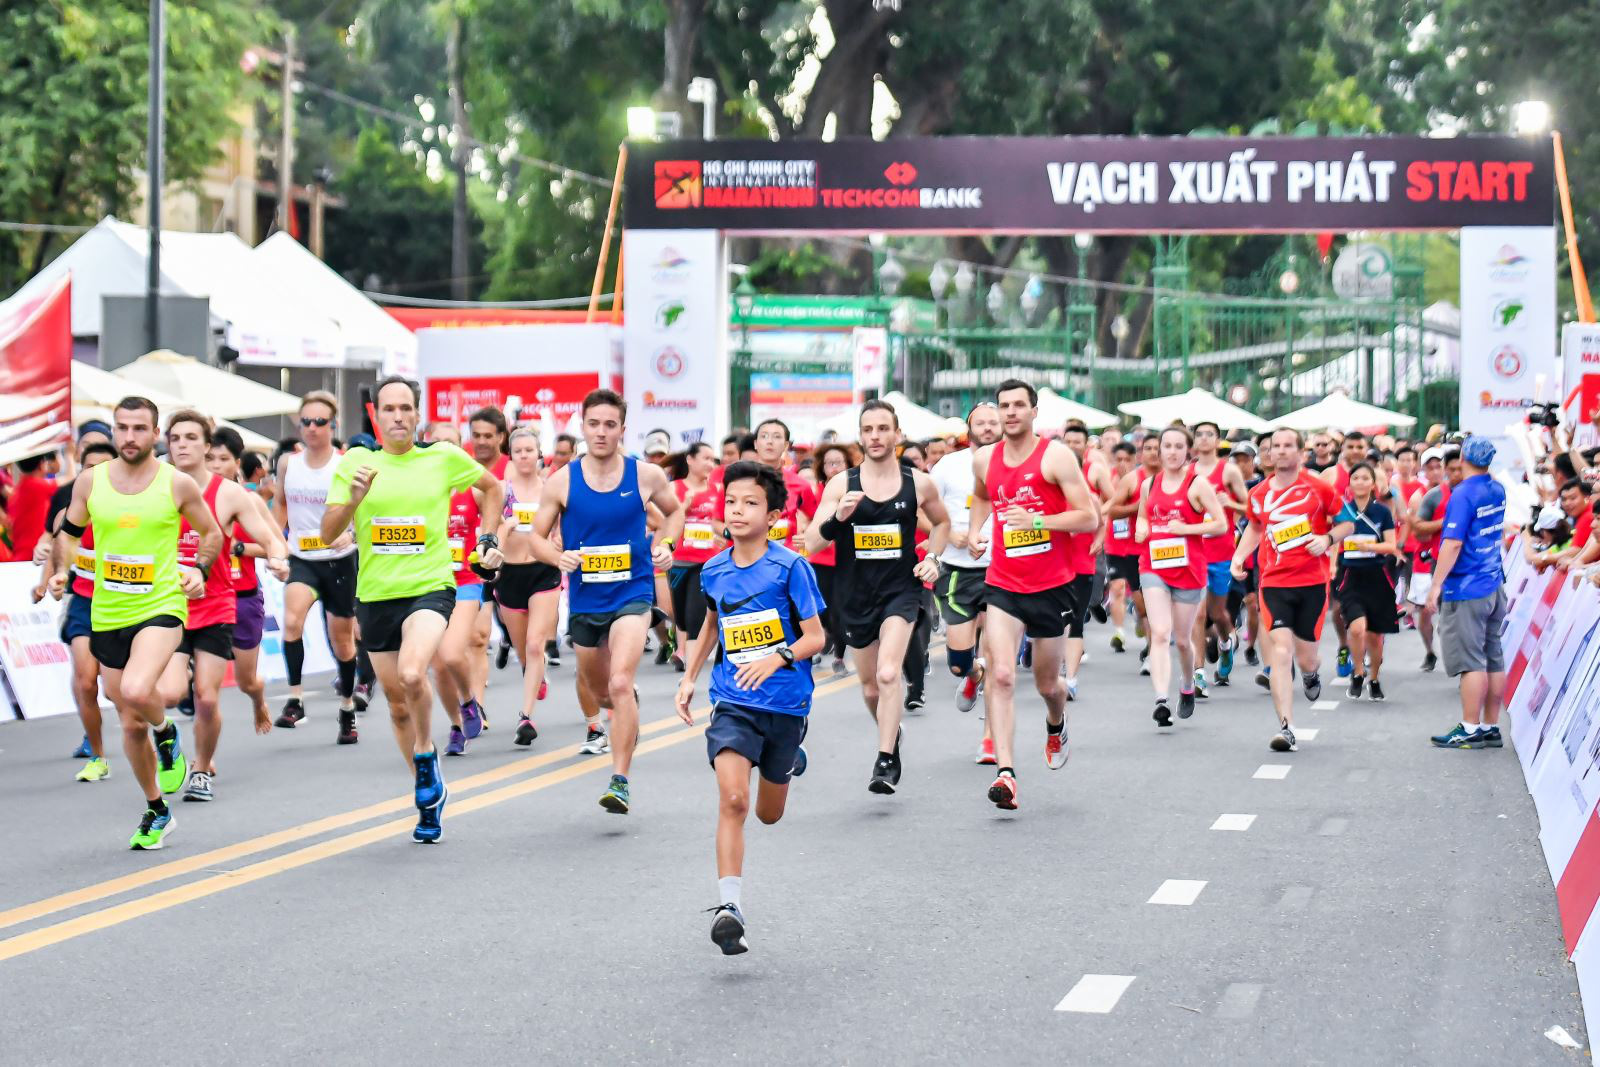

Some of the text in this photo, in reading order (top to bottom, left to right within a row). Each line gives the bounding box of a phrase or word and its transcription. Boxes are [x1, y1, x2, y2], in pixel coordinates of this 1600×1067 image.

[703, 160, 816, 176] HO CHI MINH CITY
[703, 175, 815, 188] INTERNATIONAL
[1046, 148, 1534, 214] VẠCH XUẤT PHÁT START
[703, 187, 815, 208] MARATHON
[820, 187, 983, 209] TECHCOMBANK
[379, 528, 417, 541] F3523
[861, 535, 894, 547] F3859
[1010, 530, 1043, 544] F5594
[588, 556, 623, 569] F3775
[110, 564, 145, 579] F4287
[732, 625, 773, 646] F4158
